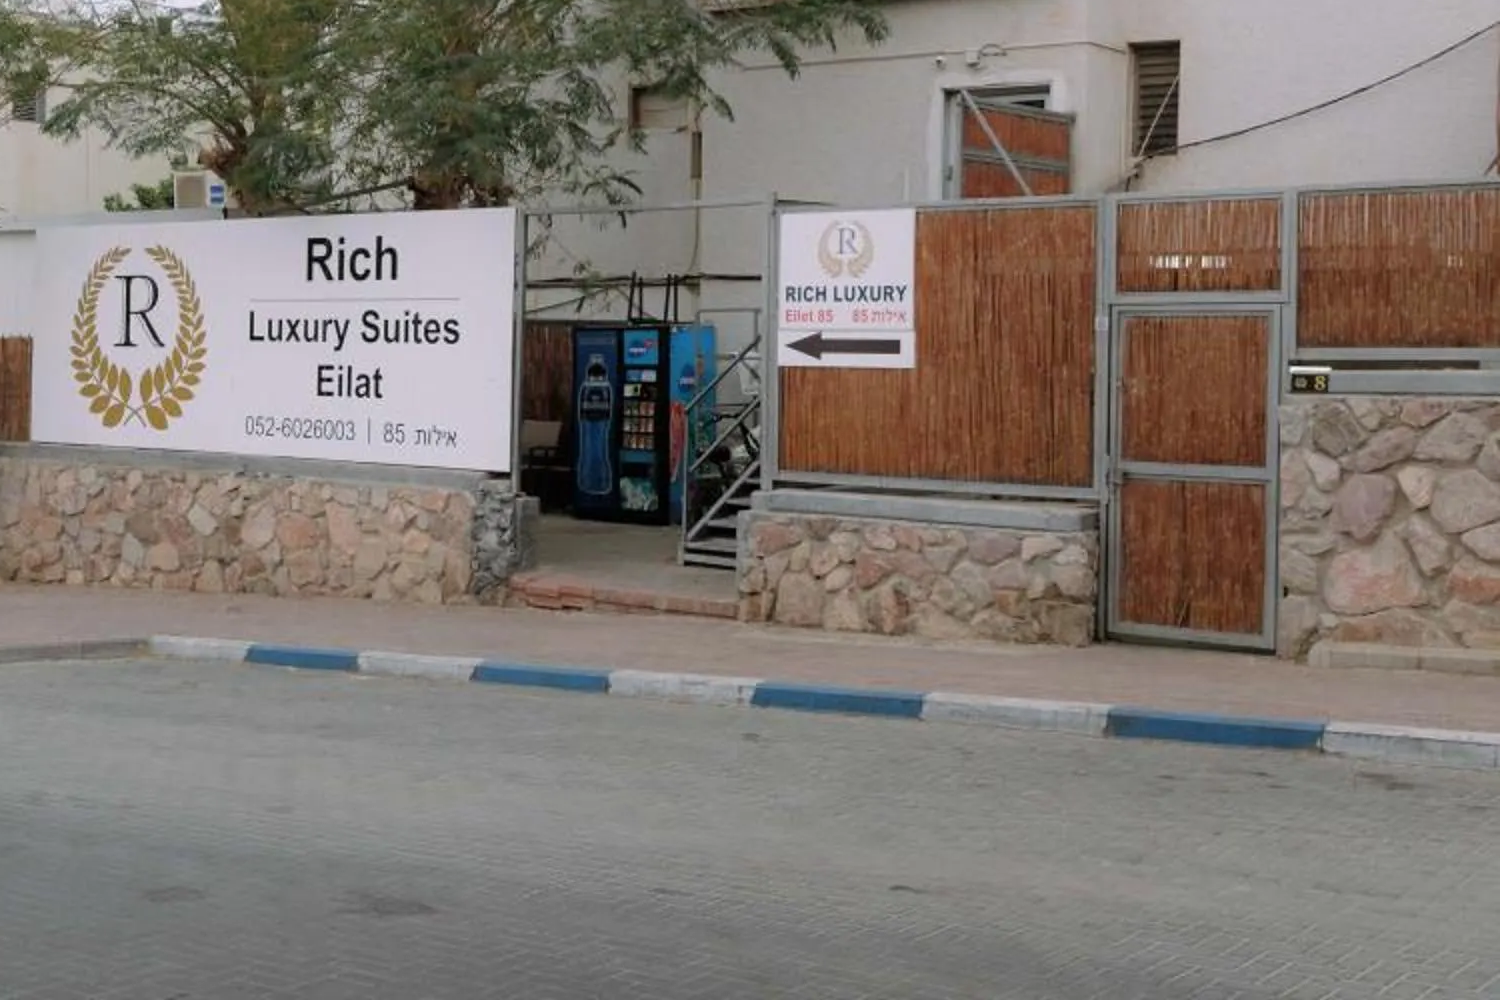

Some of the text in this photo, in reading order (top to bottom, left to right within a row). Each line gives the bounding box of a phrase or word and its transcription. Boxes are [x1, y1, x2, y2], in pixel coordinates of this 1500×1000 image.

[838, 226, 859, 255] R
[306, 235, 398, 281] Rich
[785, 285, 907, 303] RICH LUXURY
[113, 275, 165, 348] R
[817, 309, 834, 322] 85
[871, 307, 907, 322] אילות
[249, 309, 460, 351] Luxury Suites
[316, 364, 383, 399] Eilat
[245, 415, 355, 441] 052-6026003
[383, 422, 458, 448] אילות 85
